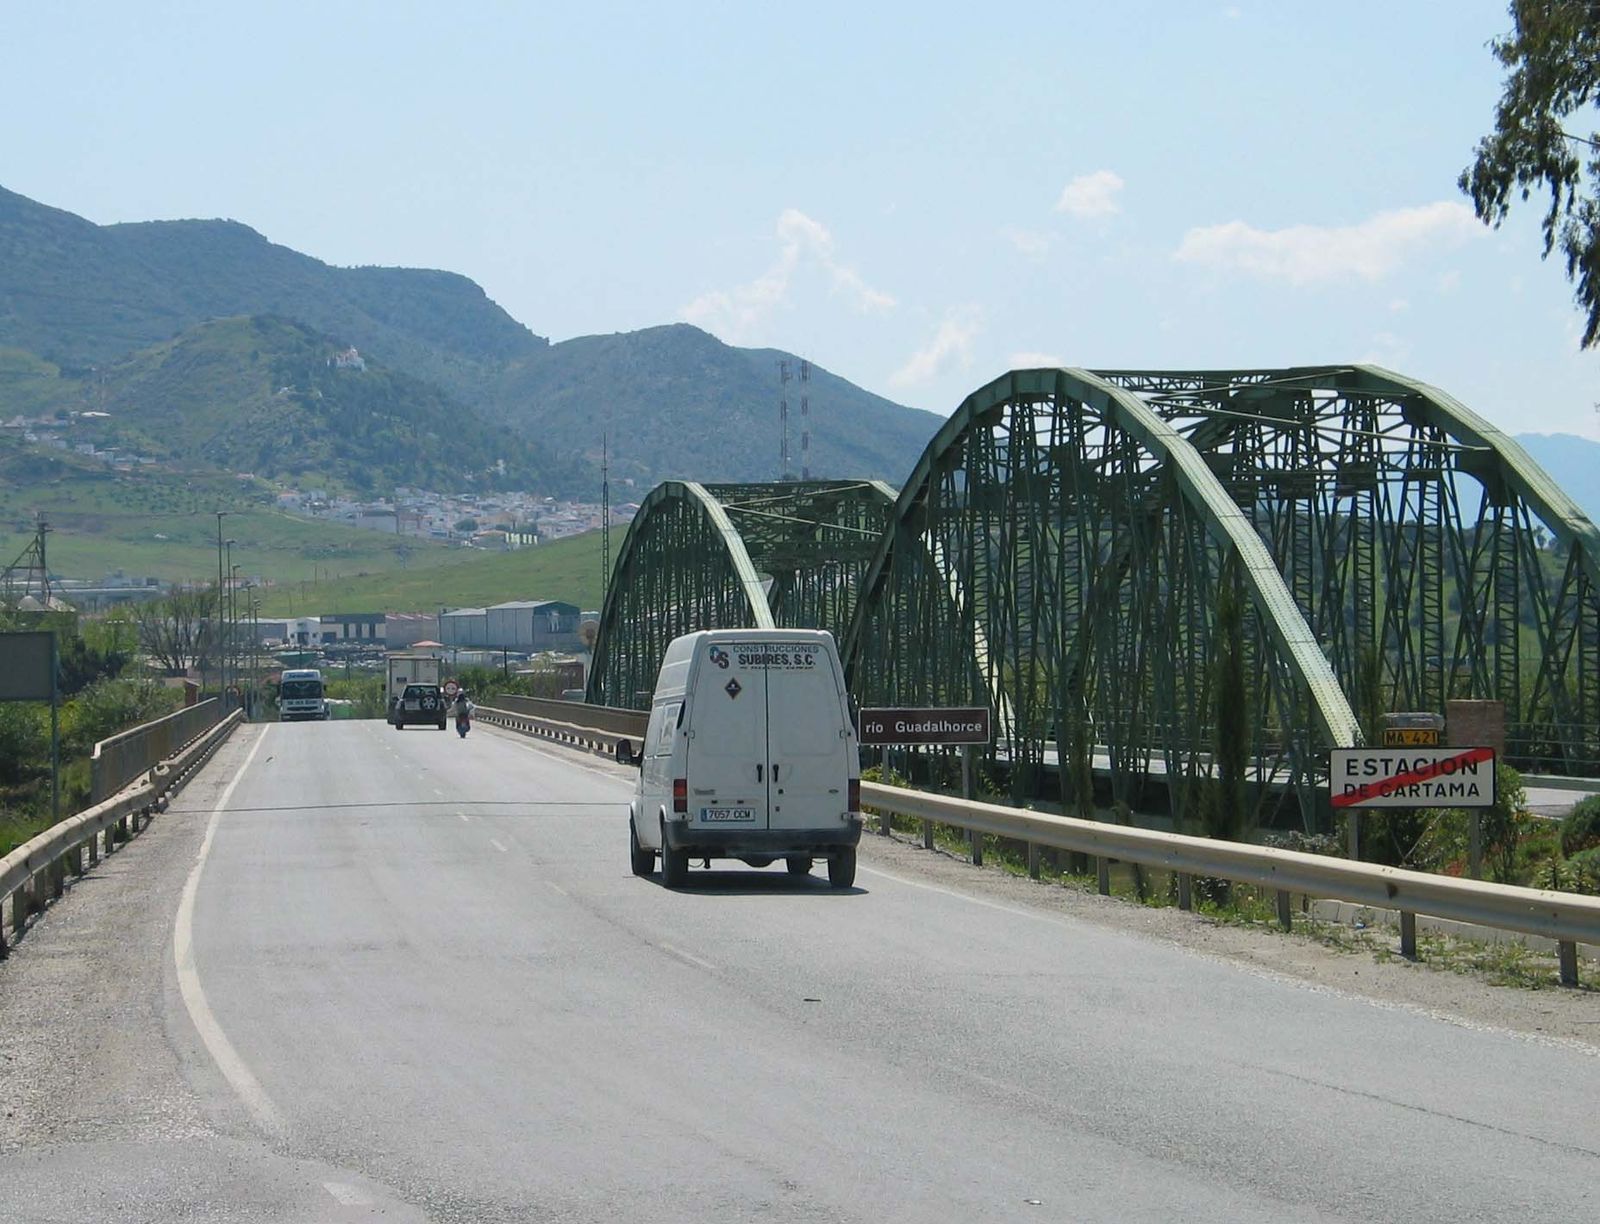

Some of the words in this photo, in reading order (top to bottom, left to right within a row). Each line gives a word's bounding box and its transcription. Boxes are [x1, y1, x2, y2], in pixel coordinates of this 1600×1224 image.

[733, 645, 819, 654] CONSTRUCCIONES
[895, 720, 983, 733] Guadalhorce
[1346, 757, 1478, 777] ESTACION
[1344, 783, 1369, 798] DE
[1380, 782, 1480, 799] CARTAMA
[709, 810, 731, 819] 7057
